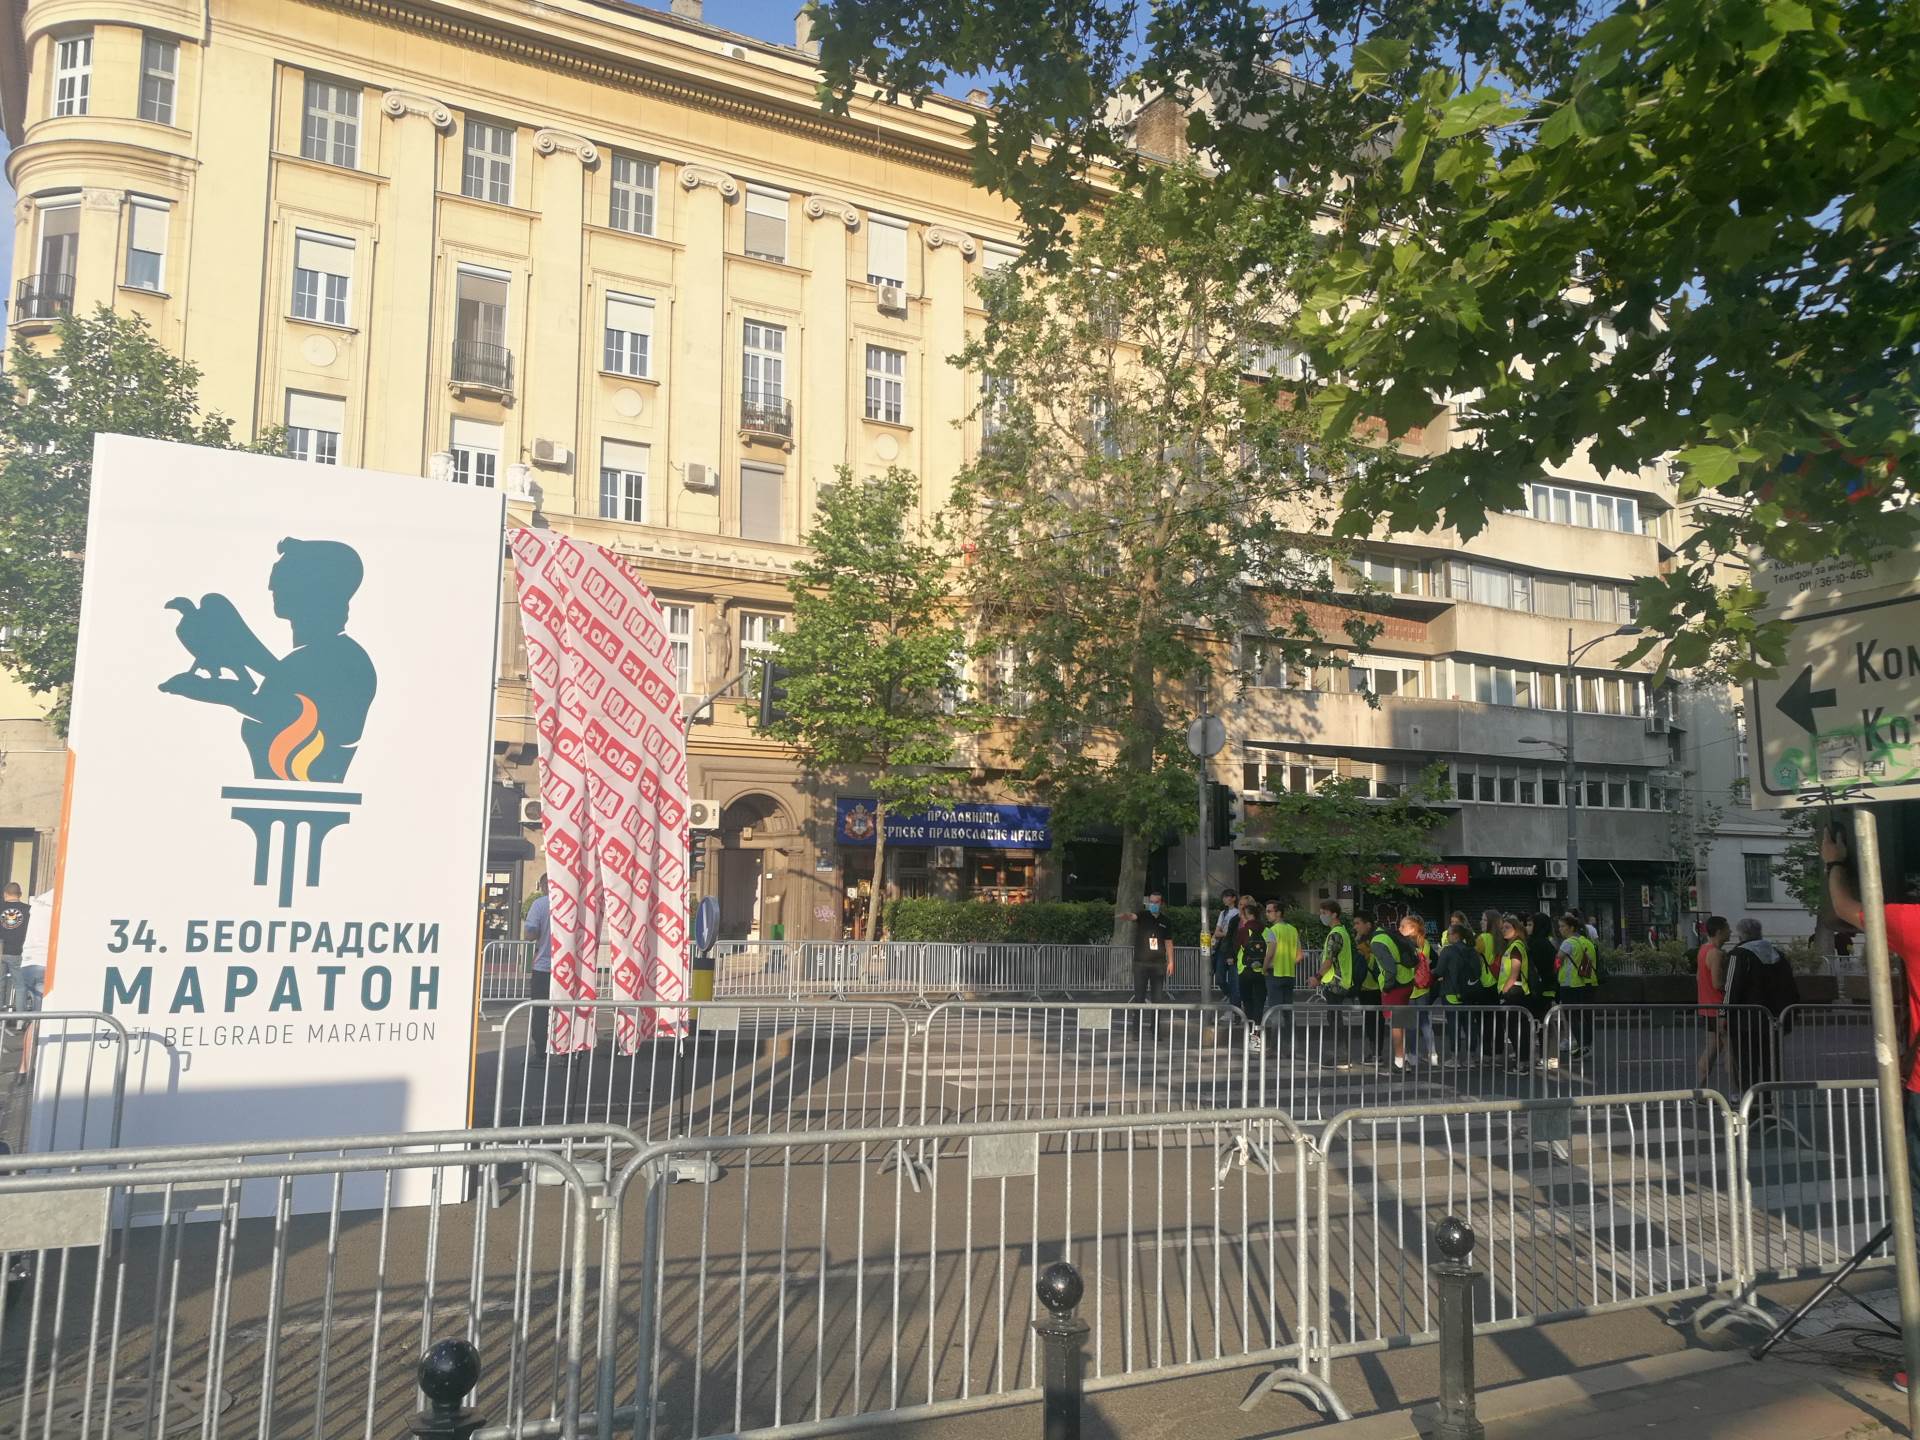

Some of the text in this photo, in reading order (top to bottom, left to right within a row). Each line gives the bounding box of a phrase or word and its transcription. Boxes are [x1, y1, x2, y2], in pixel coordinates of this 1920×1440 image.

[1862, 706, 1920, 752] Ко
[927, 810, 1000, 825] ПРОДАВНИЦА
[929, 827, 1007, 841] ПРАВОСЛАВНЕ
[1010, 829, 1045, 843] ЦРКВЕ
[107, 919, 440, 958] 34. БЕОГРАДСКИ
[102, 965, 440, 1014] МАРАТОН
[164, 1024, 295, 1048] BELGRADE
[308, 1022, 436, 1045] MARATHON
